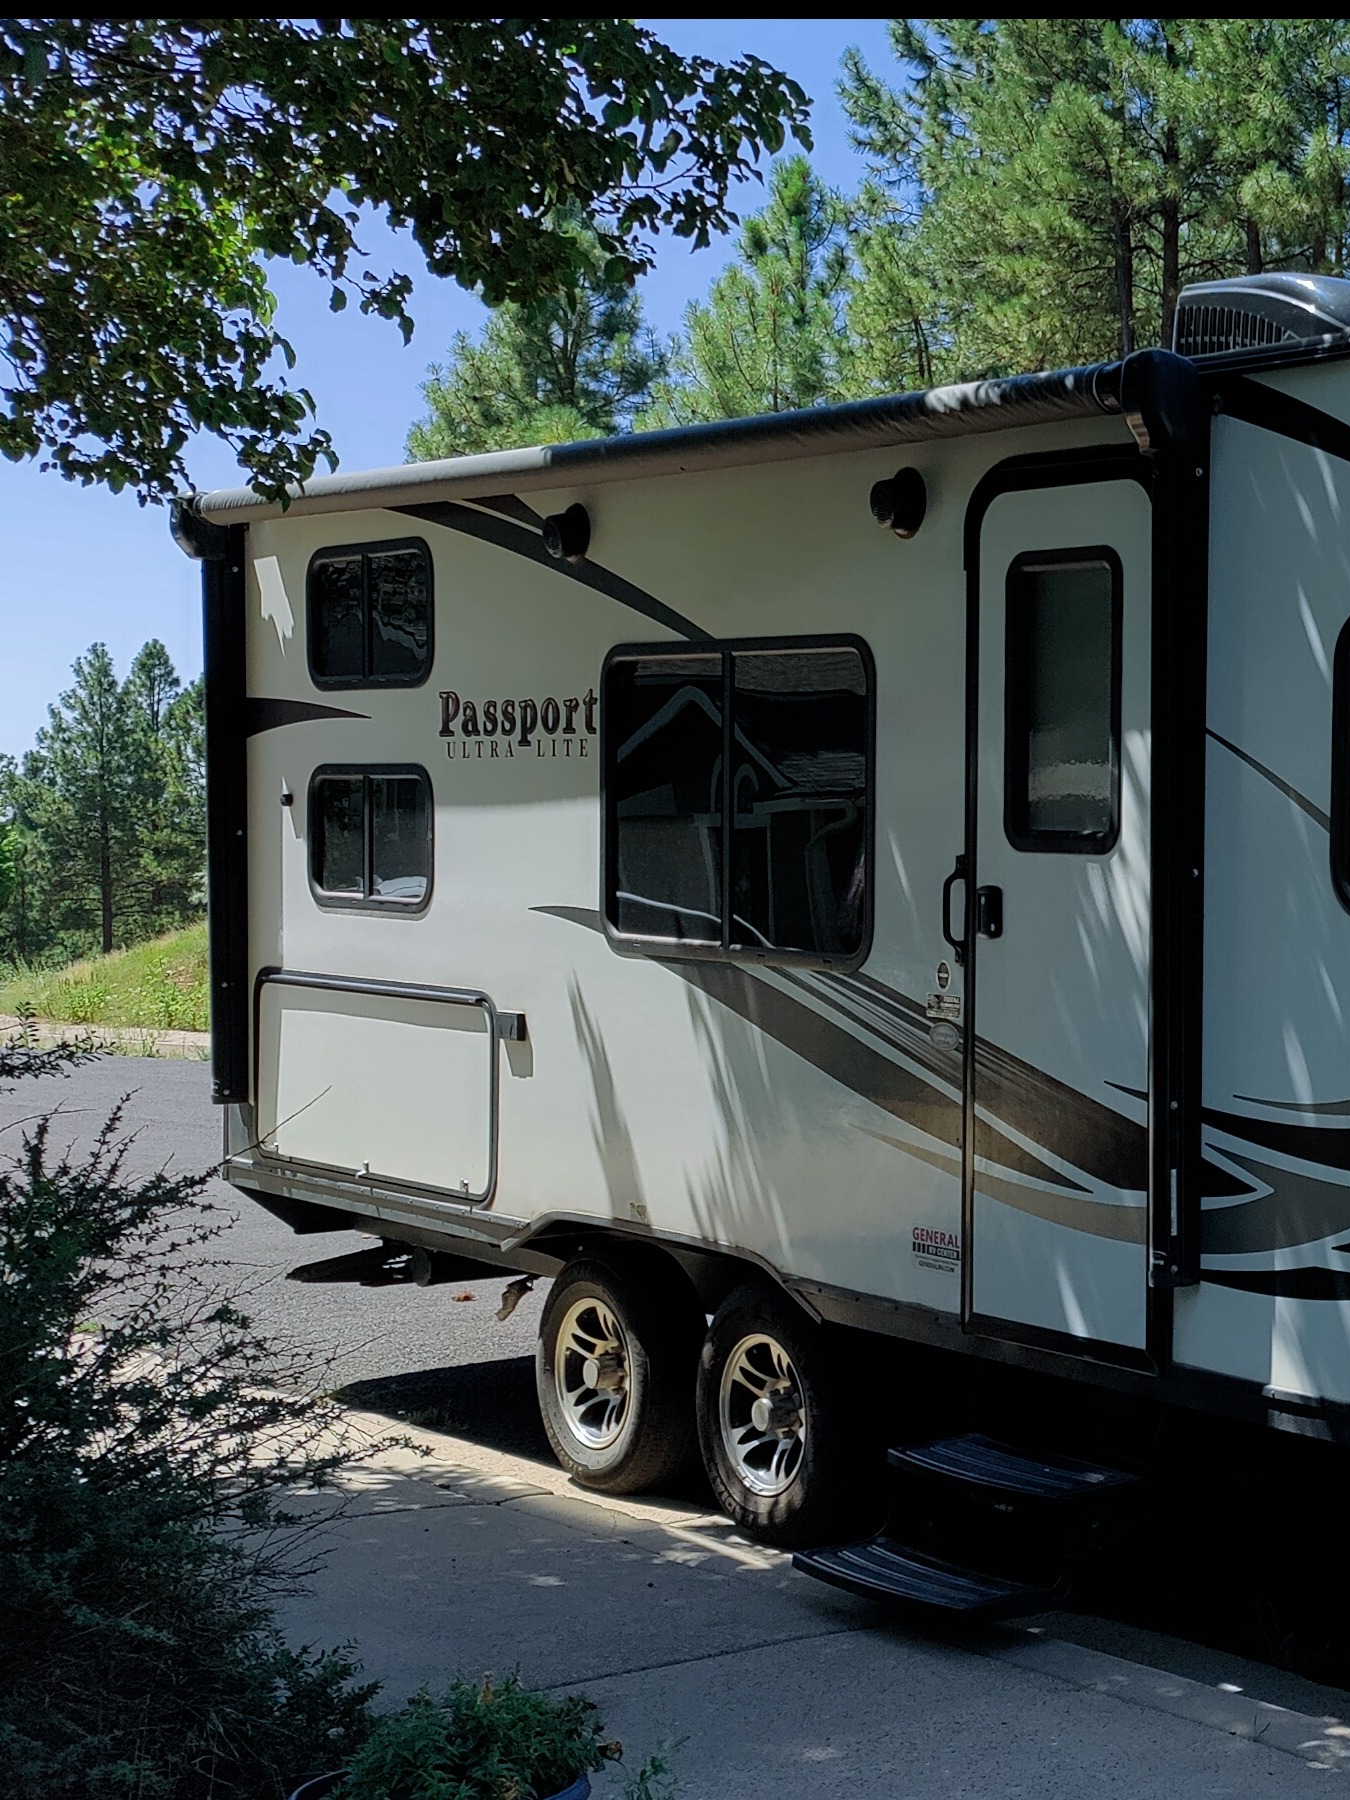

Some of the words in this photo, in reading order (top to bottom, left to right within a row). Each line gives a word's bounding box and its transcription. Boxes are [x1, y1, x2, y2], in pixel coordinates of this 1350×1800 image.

[439, 688, 598, 747] Passport
[446, 740, 515, 760] ULTRA
[536, 738, 588, 758] LITE
[912, 1226, 960, 1249] GENERAL
[936, 1247, 958, 1260] CENTER
